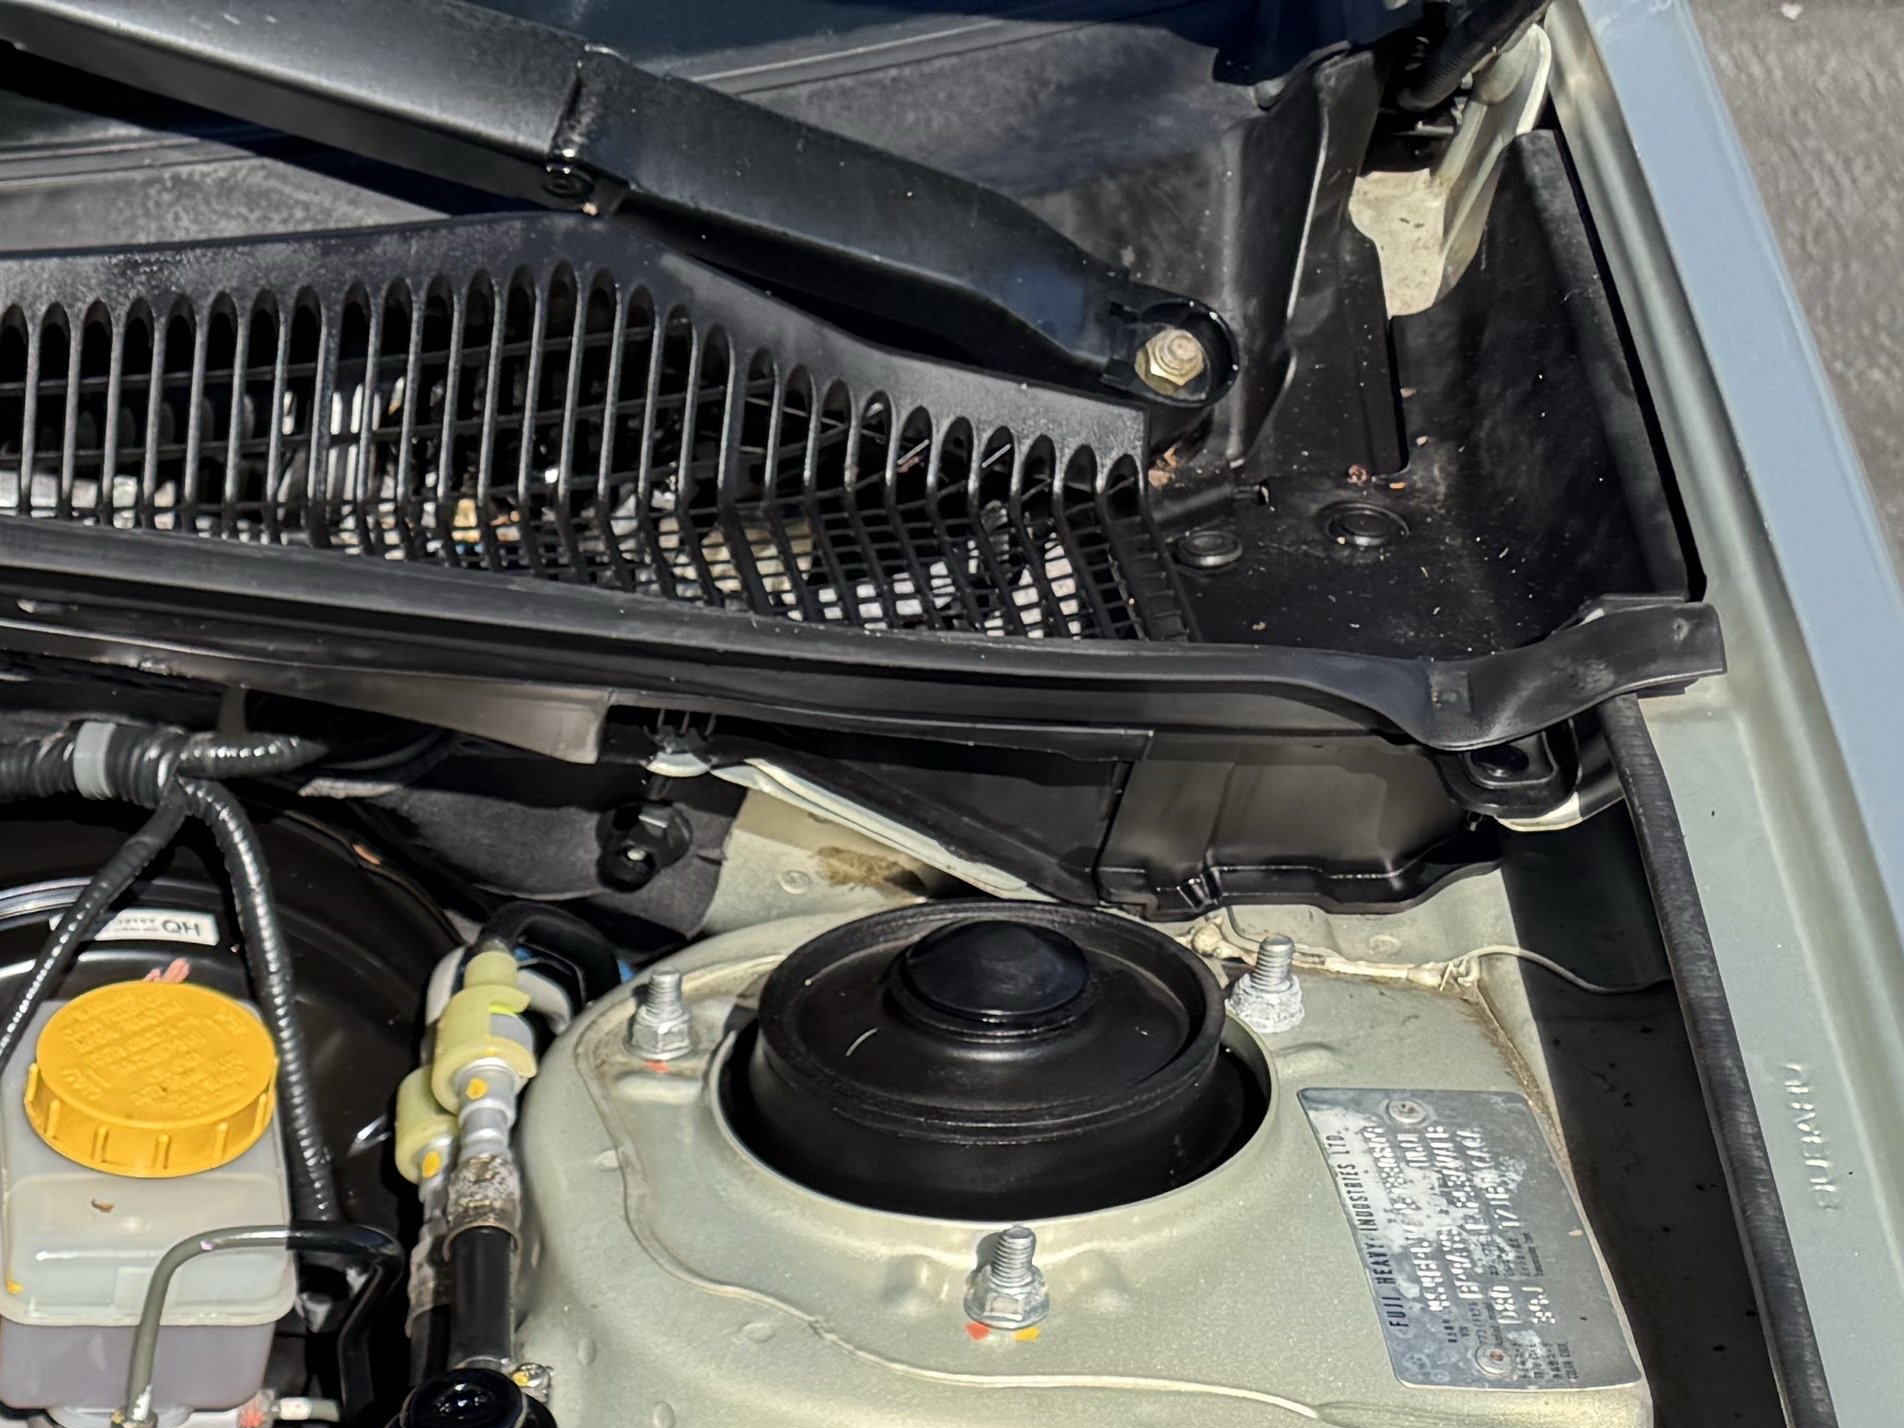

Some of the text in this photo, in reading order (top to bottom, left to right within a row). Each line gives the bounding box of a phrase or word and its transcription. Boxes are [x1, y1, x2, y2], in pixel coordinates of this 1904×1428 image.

[1341, 1163, 1378, 1232] INDUSTRIES
[1366, 1242, 1397, 1286] HEAVY
[1388, 1297, 1409, 1328] FUJI
